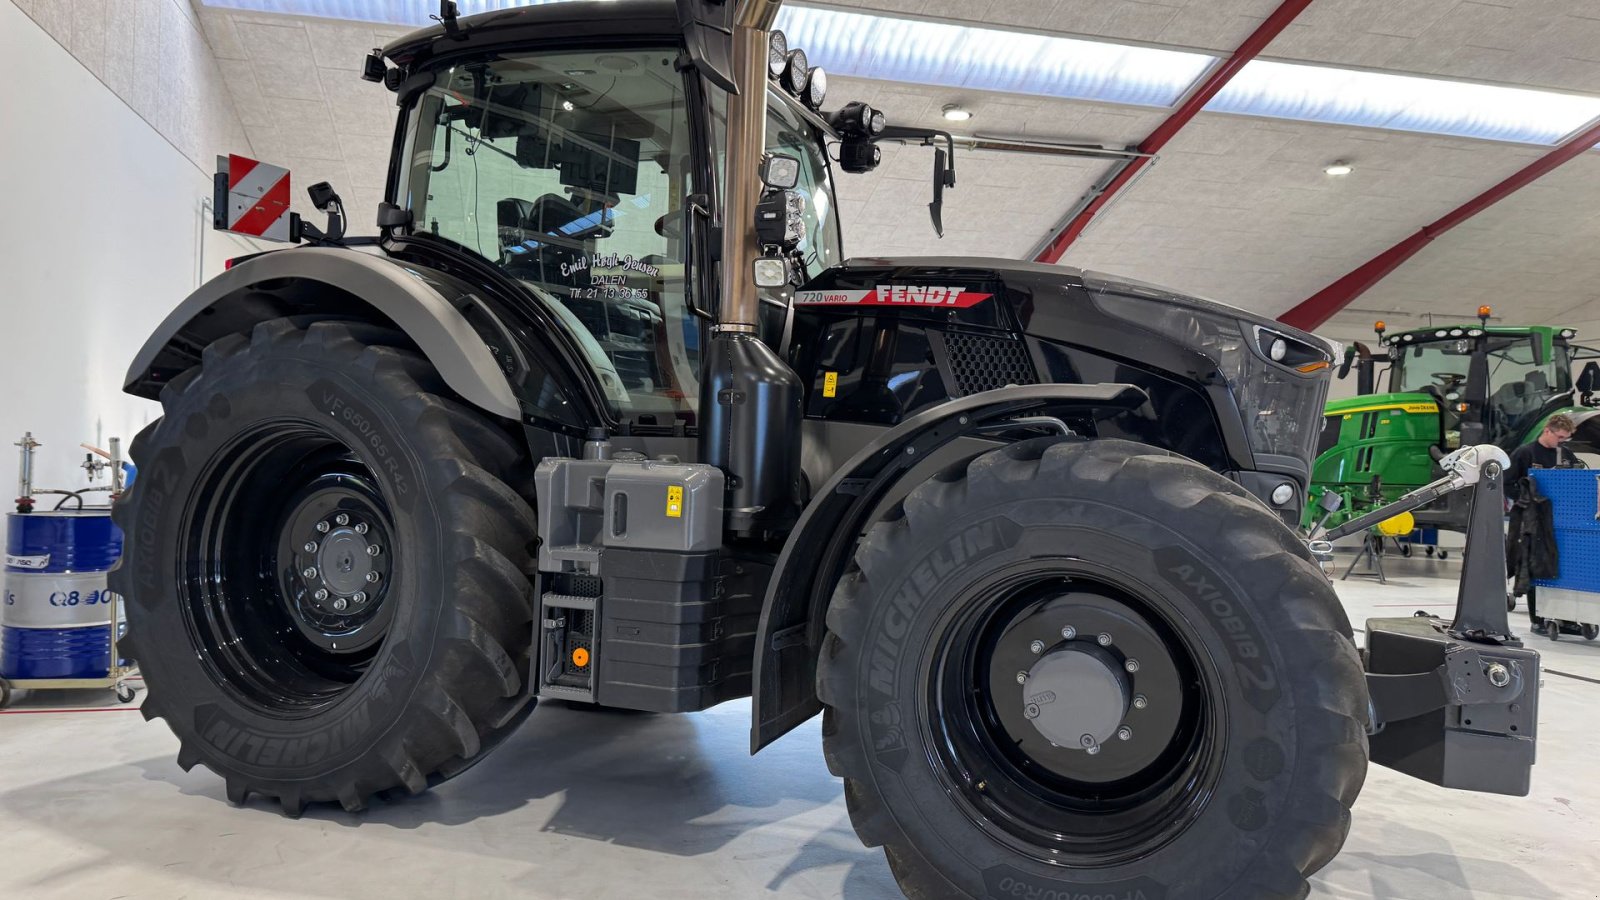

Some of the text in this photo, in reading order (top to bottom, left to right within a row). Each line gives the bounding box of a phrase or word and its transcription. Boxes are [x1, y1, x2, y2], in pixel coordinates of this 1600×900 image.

[560, 256, 588, 277] Emil
[622, 254, 659, 277] Jensen
[590, 275, 627, 286] DALEN
[569, 287, 649, 299] Tlf. 21 13 36 55
[802, 292, 848, 303] 720 VARIO
[875, 284, 967, 305] FENDT
[322, 390, 345, 412] VF
[138, 458, 180, 590] AXIOBIB 2
[49, 590, 80, 607] Q8
[869, 518, 996, 698] MICHELIN
[1168, 564, 1260, 659] AXIOBIB
[1235, 661, 1277, 691] 2
[203, 700, 372, 767] MICHELIN
